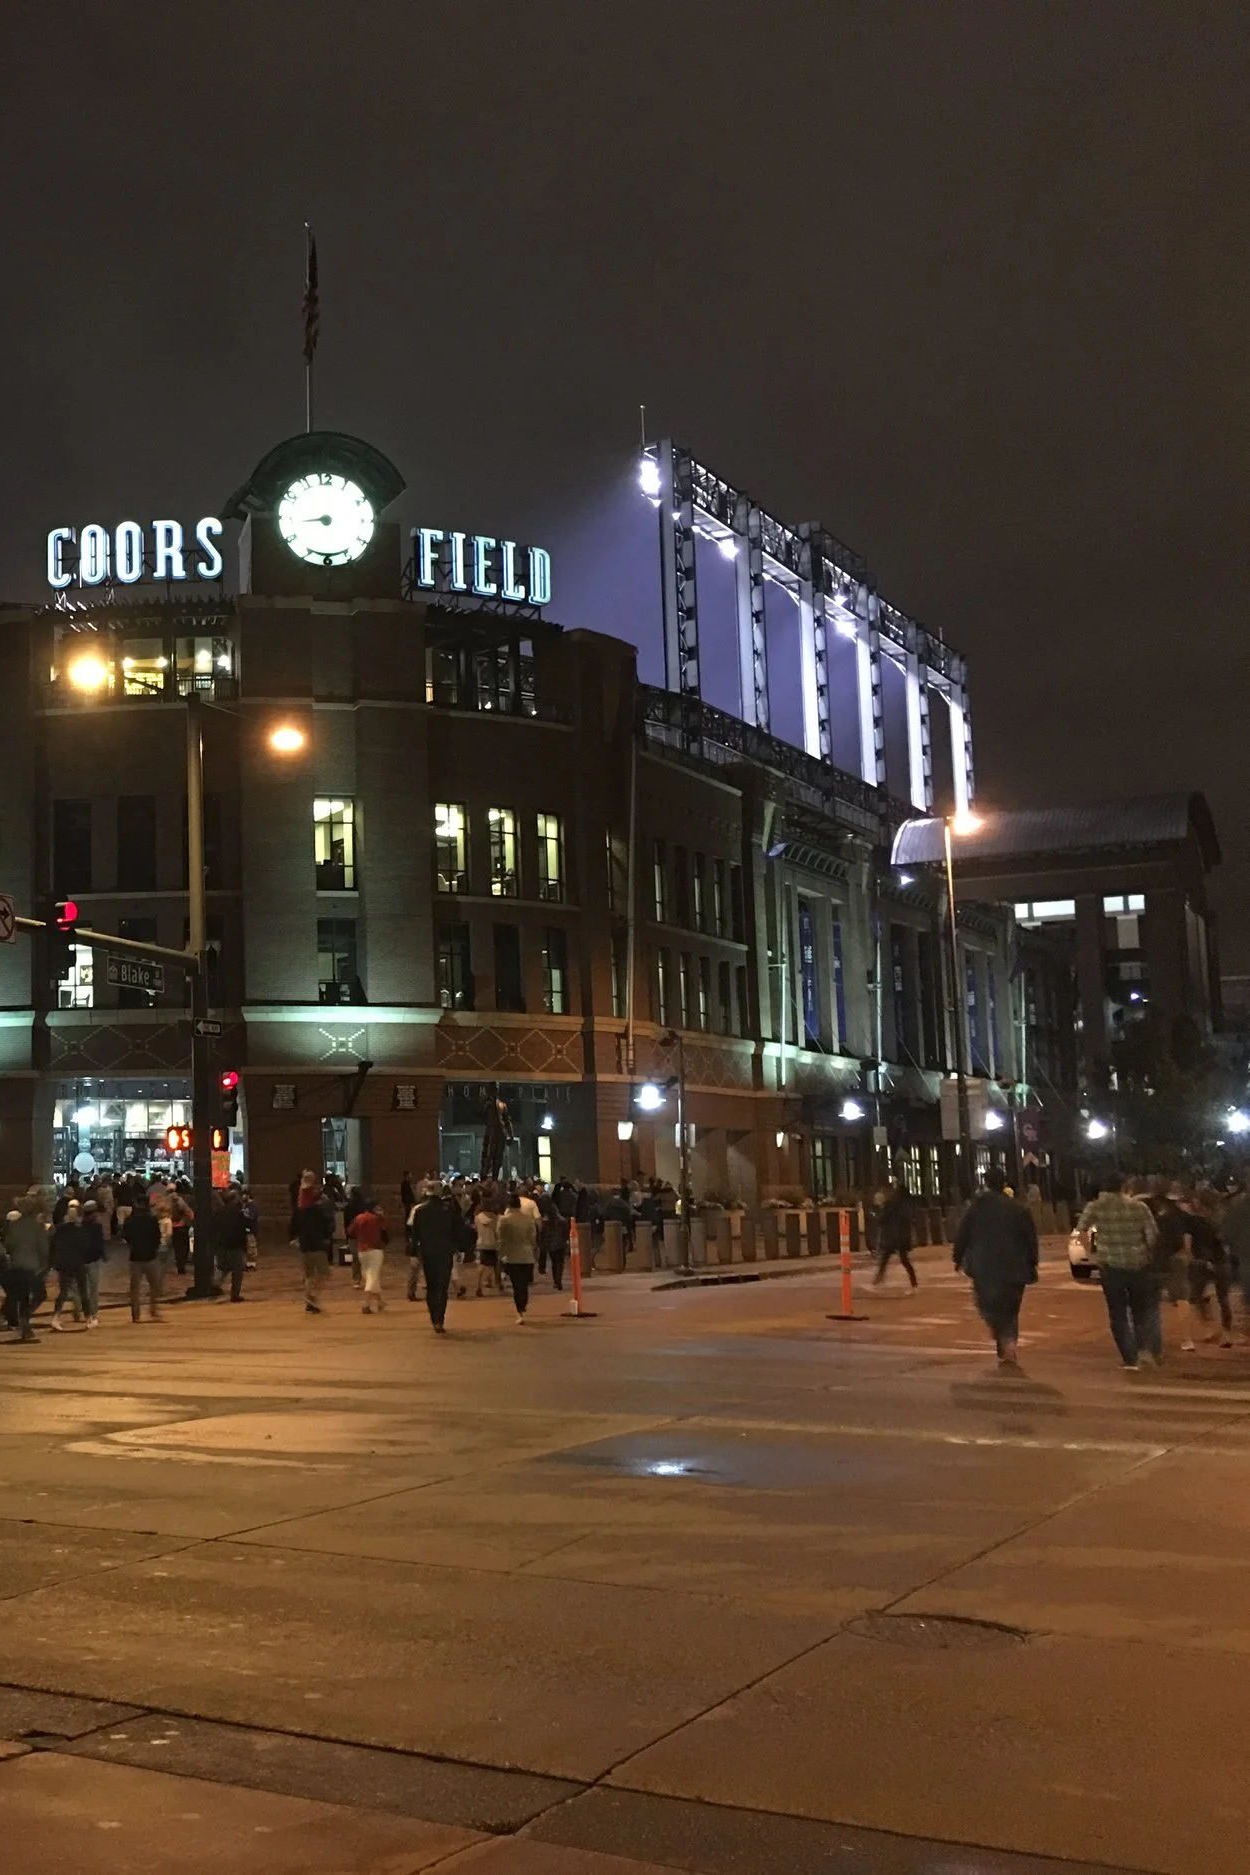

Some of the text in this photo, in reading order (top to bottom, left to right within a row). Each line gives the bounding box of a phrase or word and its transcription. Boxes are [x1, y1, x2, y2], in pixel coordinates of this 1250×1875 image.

[47, 516, 552, 605] COORS FIELD
[121, 964, 150, 986] Blake
